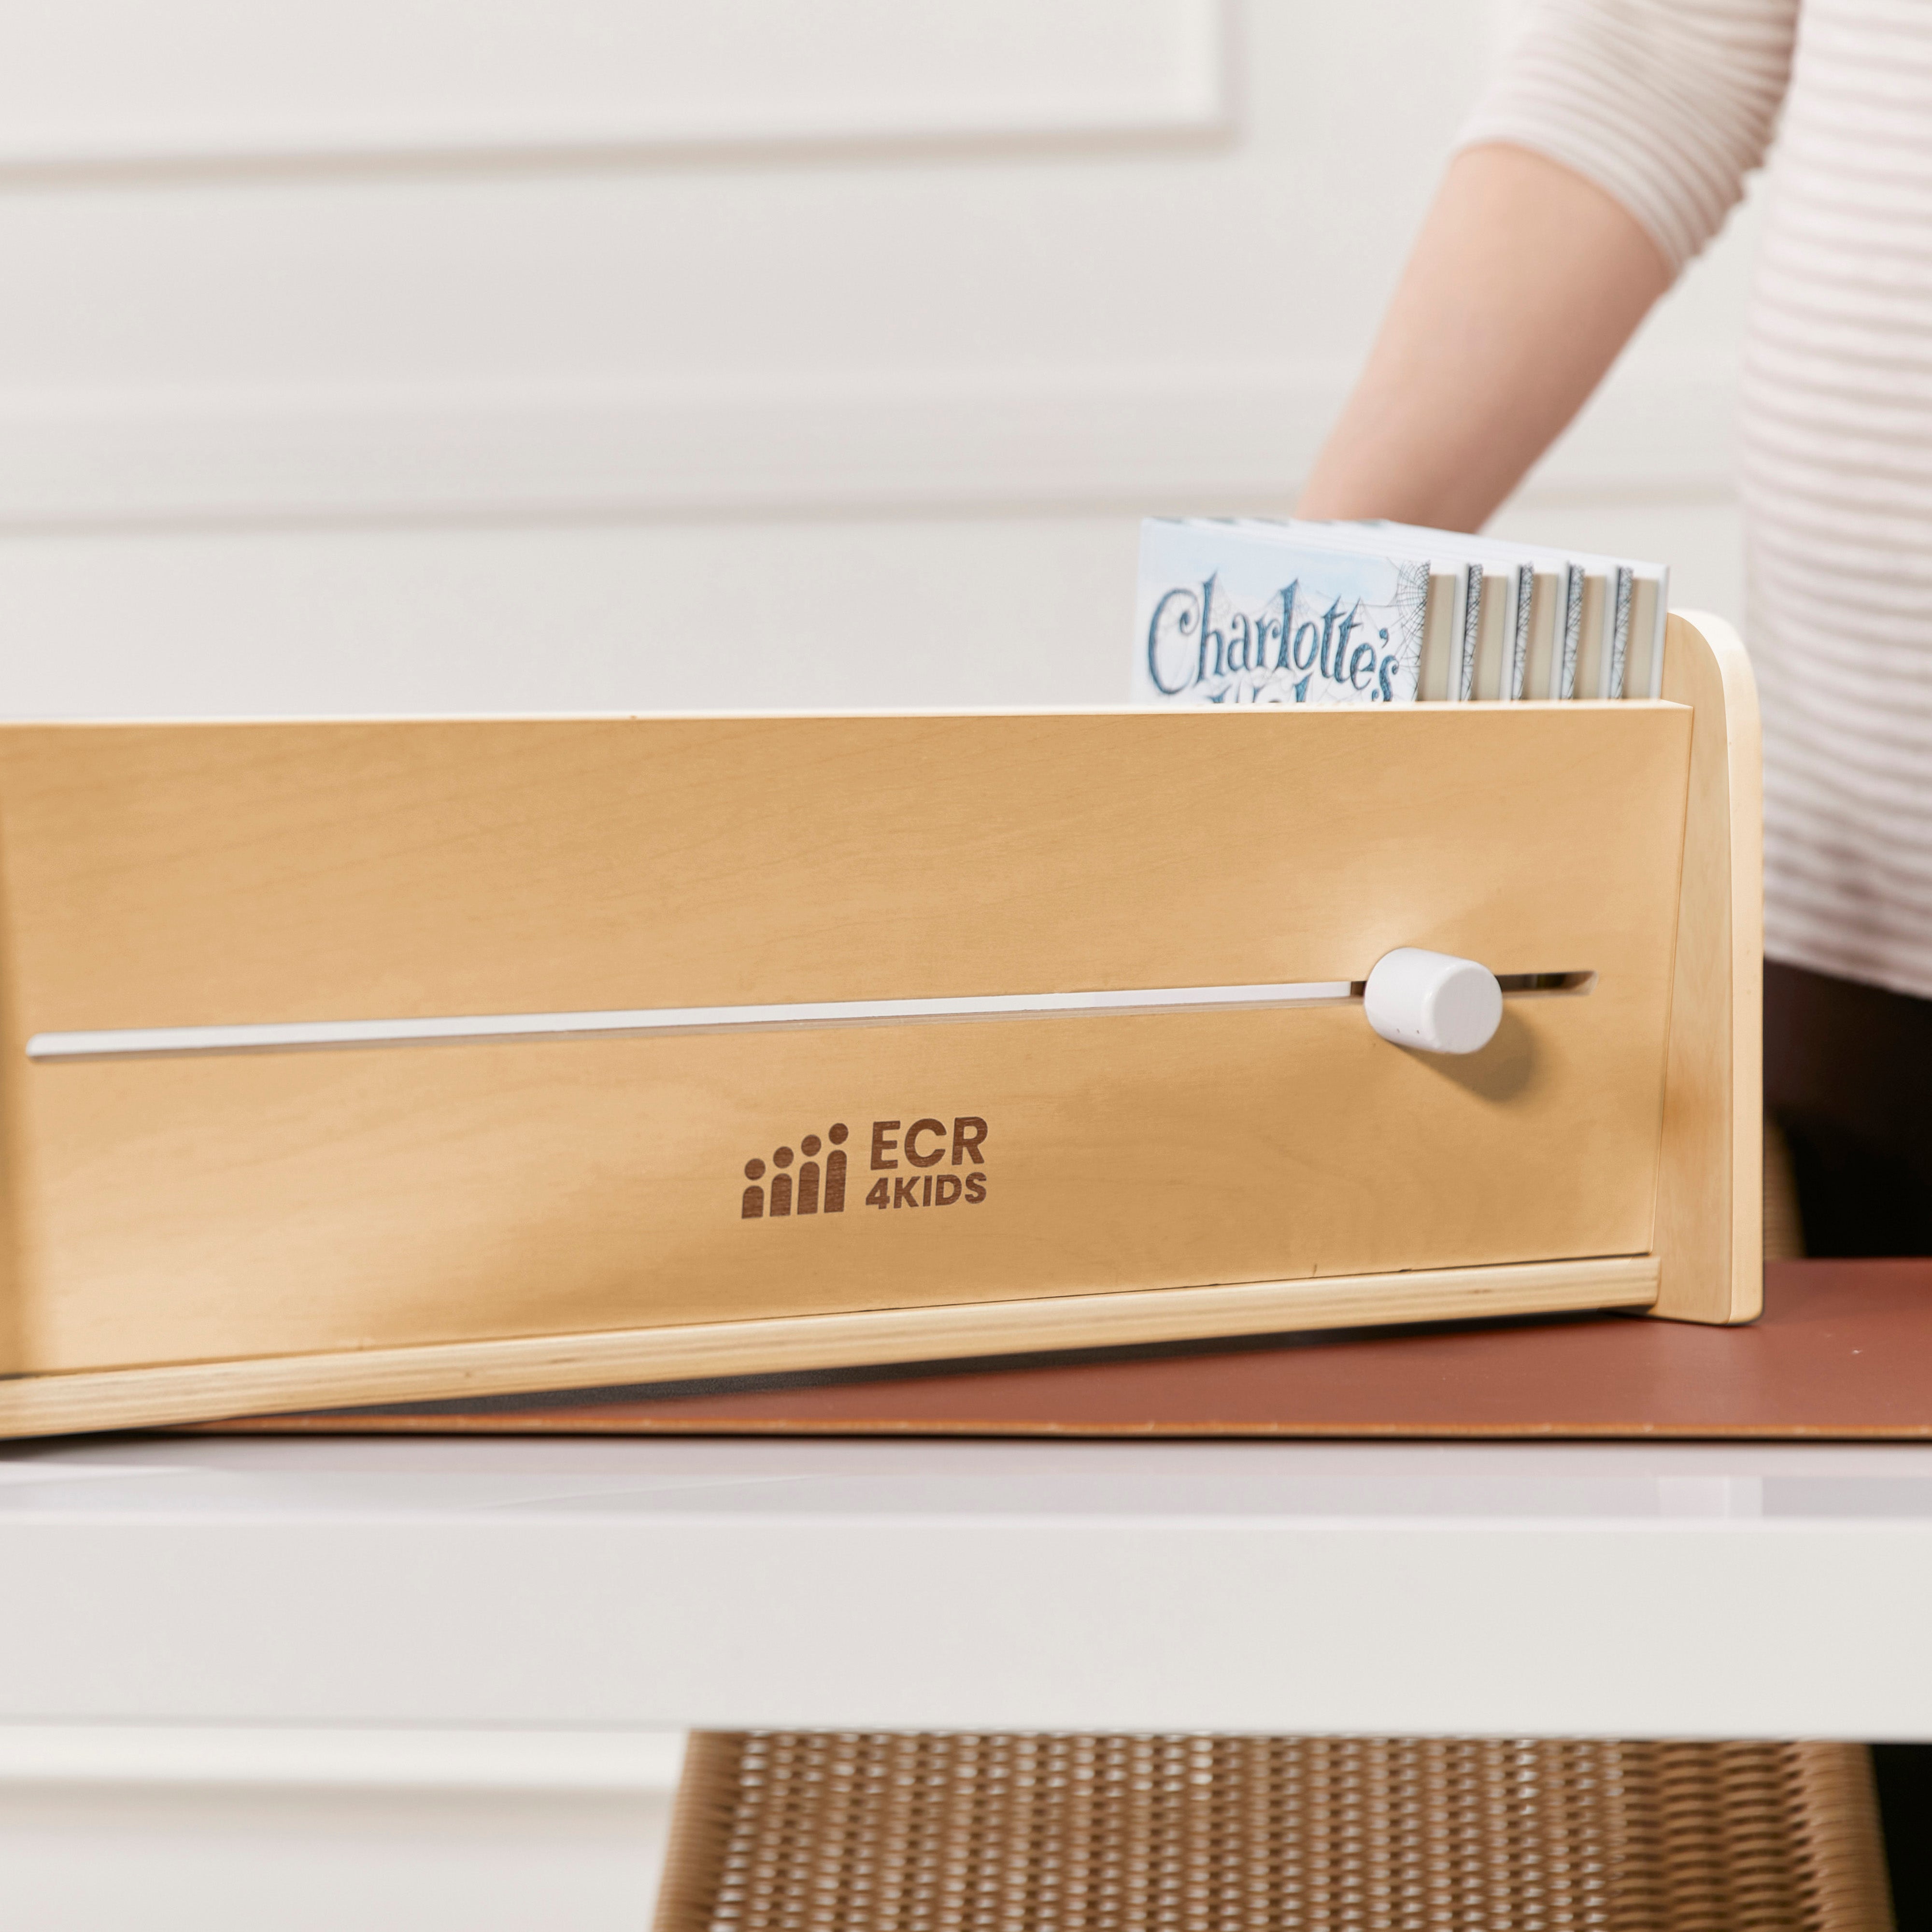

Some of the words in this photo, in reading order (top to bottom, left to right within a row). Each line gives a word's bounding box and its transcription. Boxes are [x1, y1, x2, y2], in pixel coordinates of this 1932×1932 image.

[1148, 570, 1399, 702] Charlotte's
[871, 1117, 988, 1170] ECR
[866, 1172, 987, 1209] 4KIDS
